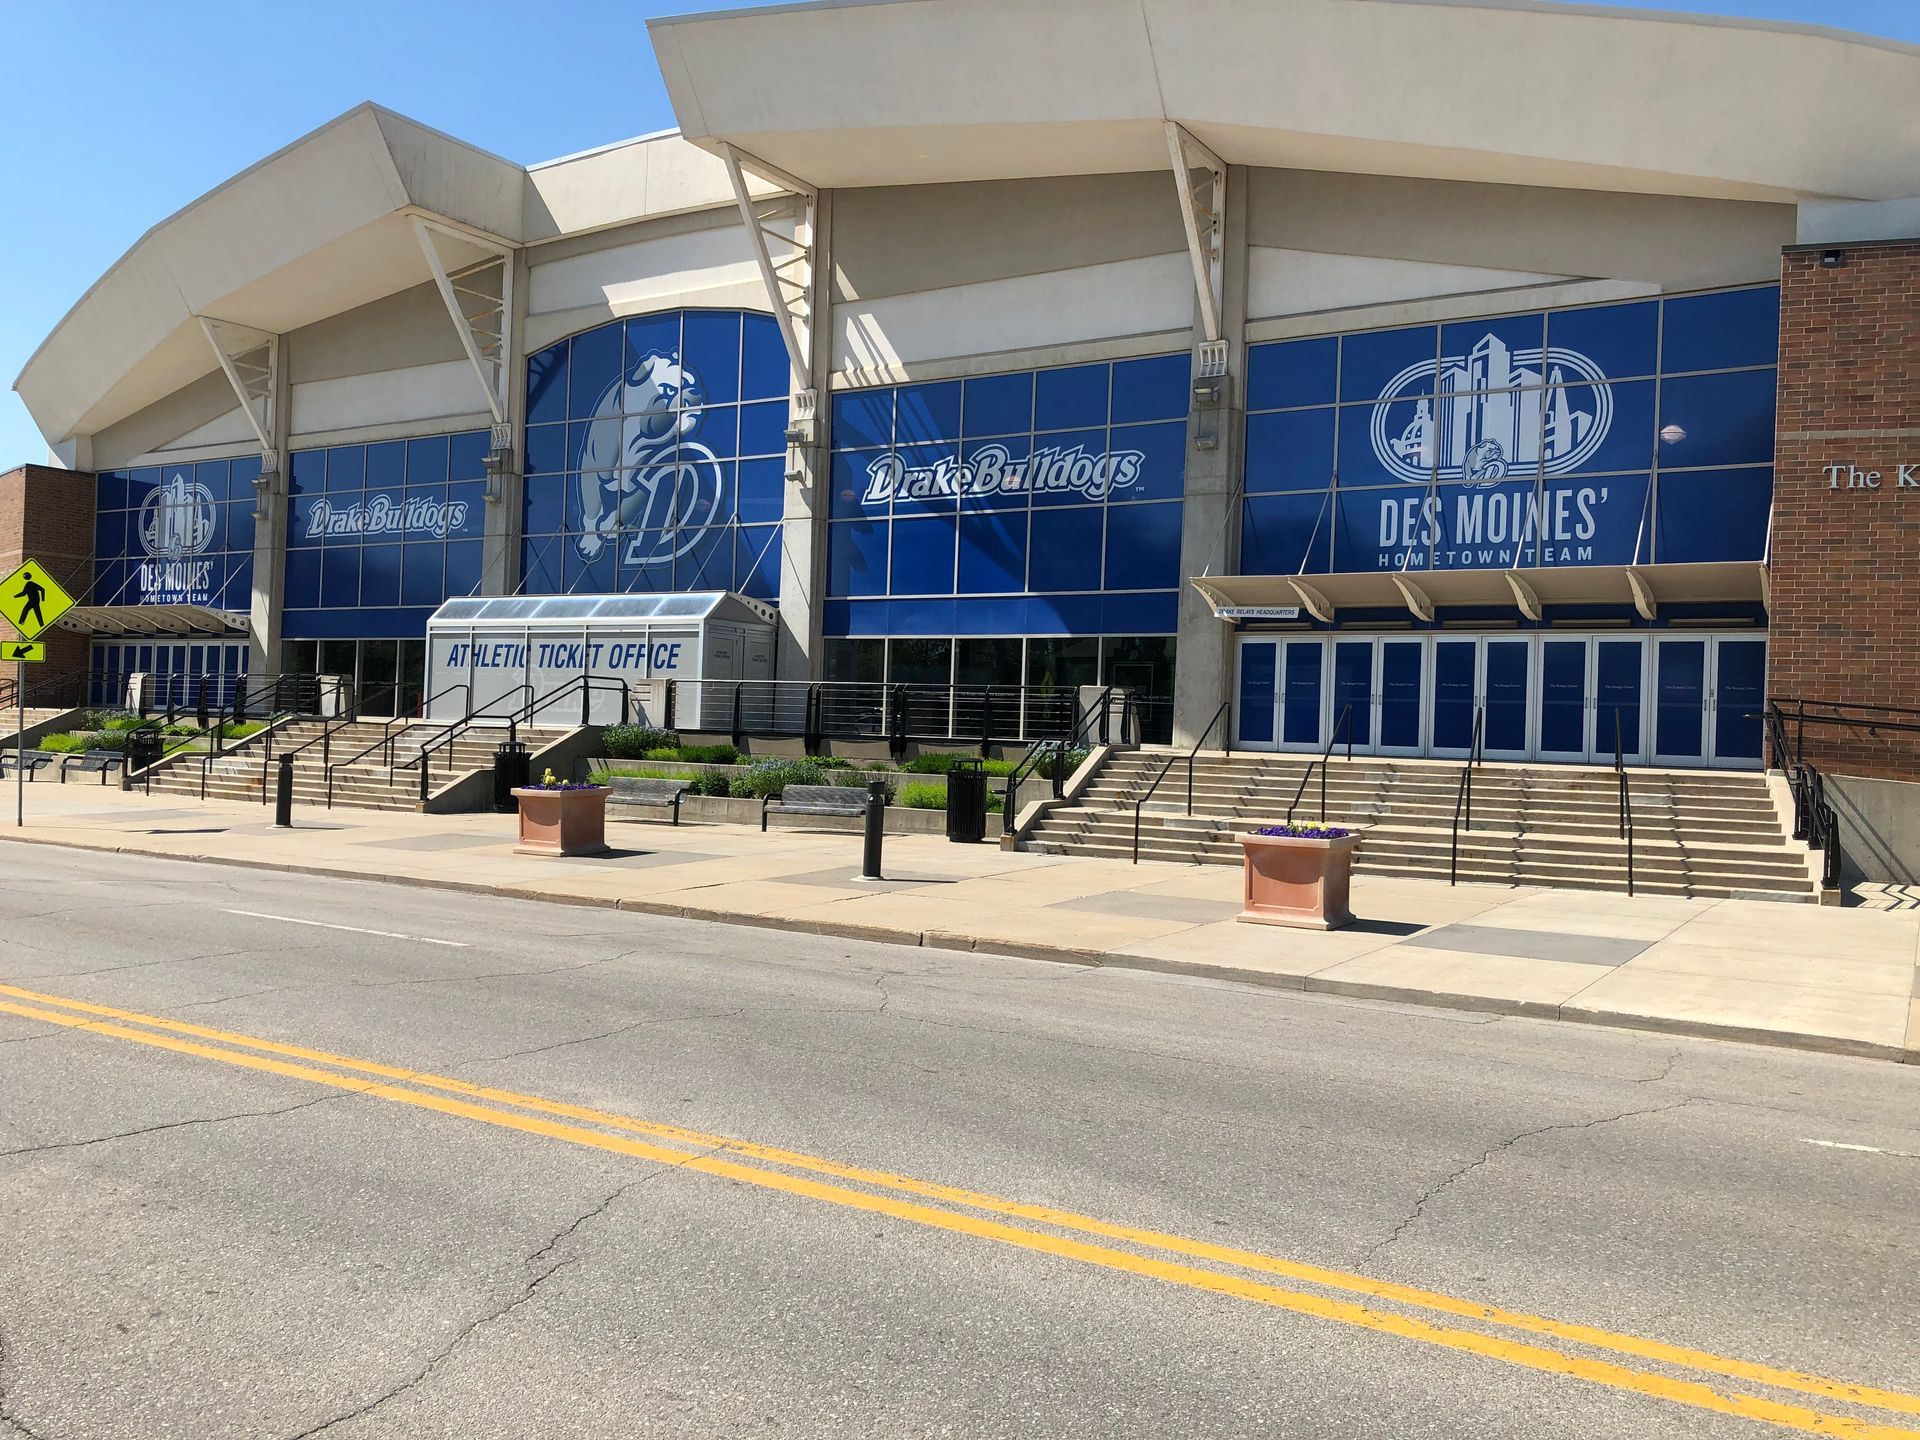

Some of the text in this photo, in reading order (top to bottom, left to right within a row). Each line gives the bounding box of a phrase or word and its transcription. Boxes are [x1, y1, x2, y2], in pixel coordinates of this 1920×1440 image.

[1823, 464, 1881, 489] The
[1379, 487, 1609, 548] DES MOINES'
[1379, 546, 1592, 567] HOMETOWN TEAM
[141, 563, 161, 592] DES
[187, 593, 208, 602] TEAM
[447, 643, 681, 670] ATHLETIC TICKET OFFICE
